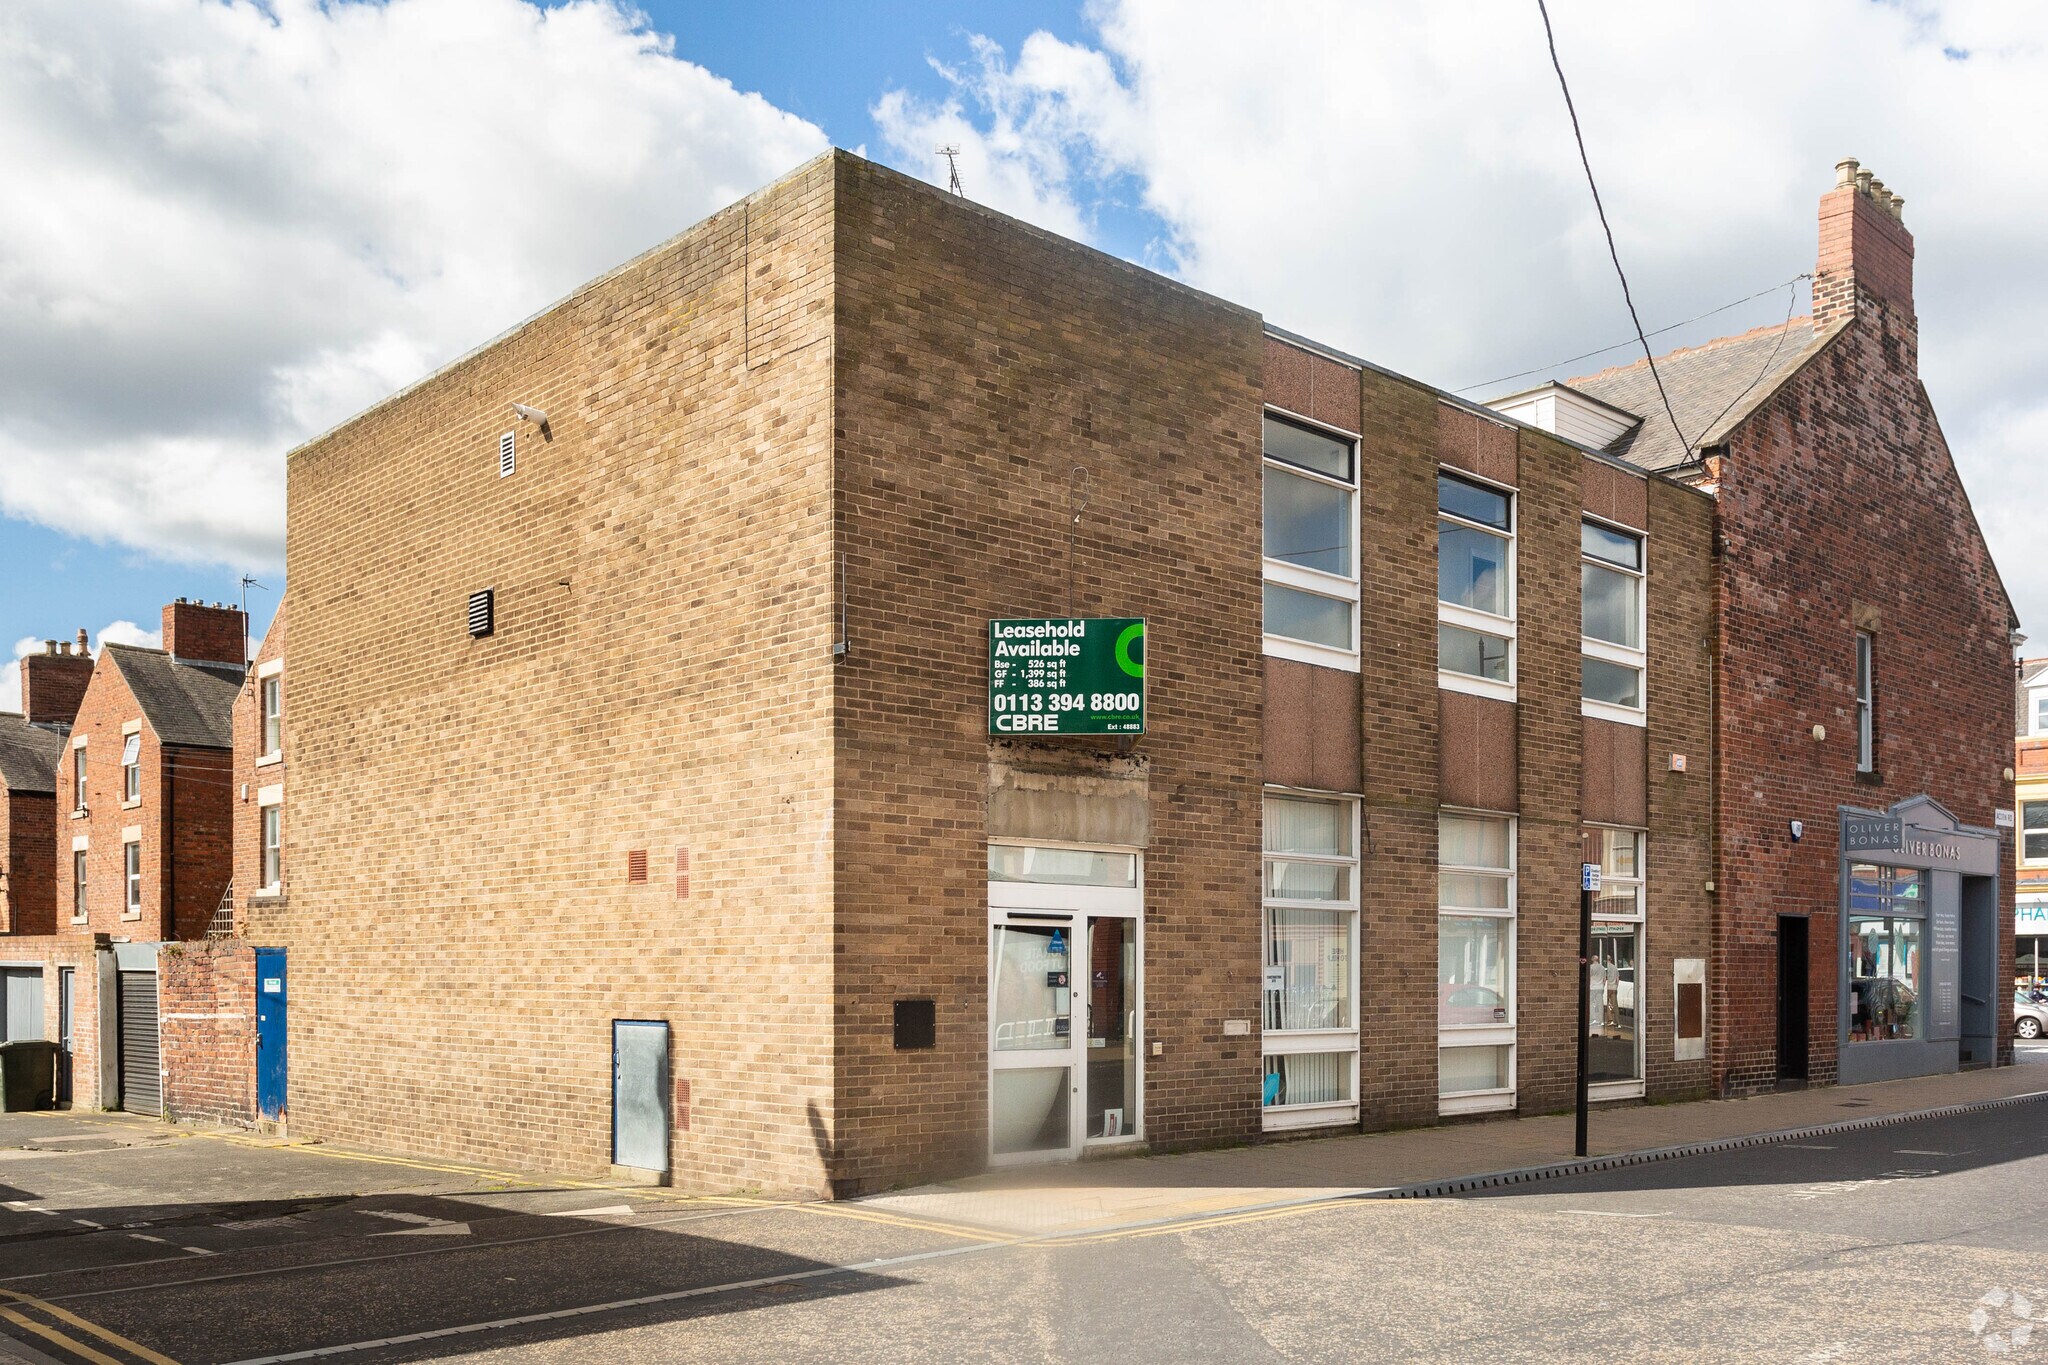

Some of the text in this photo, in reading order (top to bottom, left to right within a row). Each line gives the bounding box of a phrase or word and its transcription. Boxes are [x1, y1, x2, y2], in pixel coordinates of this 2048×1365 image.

[994, 620, 1085, 638] Leasehold
[994, 639, 1081, 657] Available
[994, 660, 1010, 669] Bse
[1027, 659, 1045, 668] 526
[1046, 661, 1057, 670] sq
[1059, 658, 1067, 668] ft
[994, 670, 1007, 679] GF
[1020, 669, 1045, 680] 1,399
[1046, 671, 1057, 680] sq
[1059, 669, 1067, 678] ft
[994, 680, 1005, 688] FF
[1027, 679, 1045, 688] 386
[1046, 681, 1057, 690] sq
[1059, 679, 1067, 688] ft
[993, 692, 1140, 712] 0113 394 8800
[995, 713, 1059, 731] CBRE
[1849, 822, 1899, 834] OLIVER
[1849, 834, 1899, 846] BONAS
[1929, 843, 1961, 860] BONAS
[1586, 867, 1589, 875] P
[2015, 906, 2048, 921] HA
